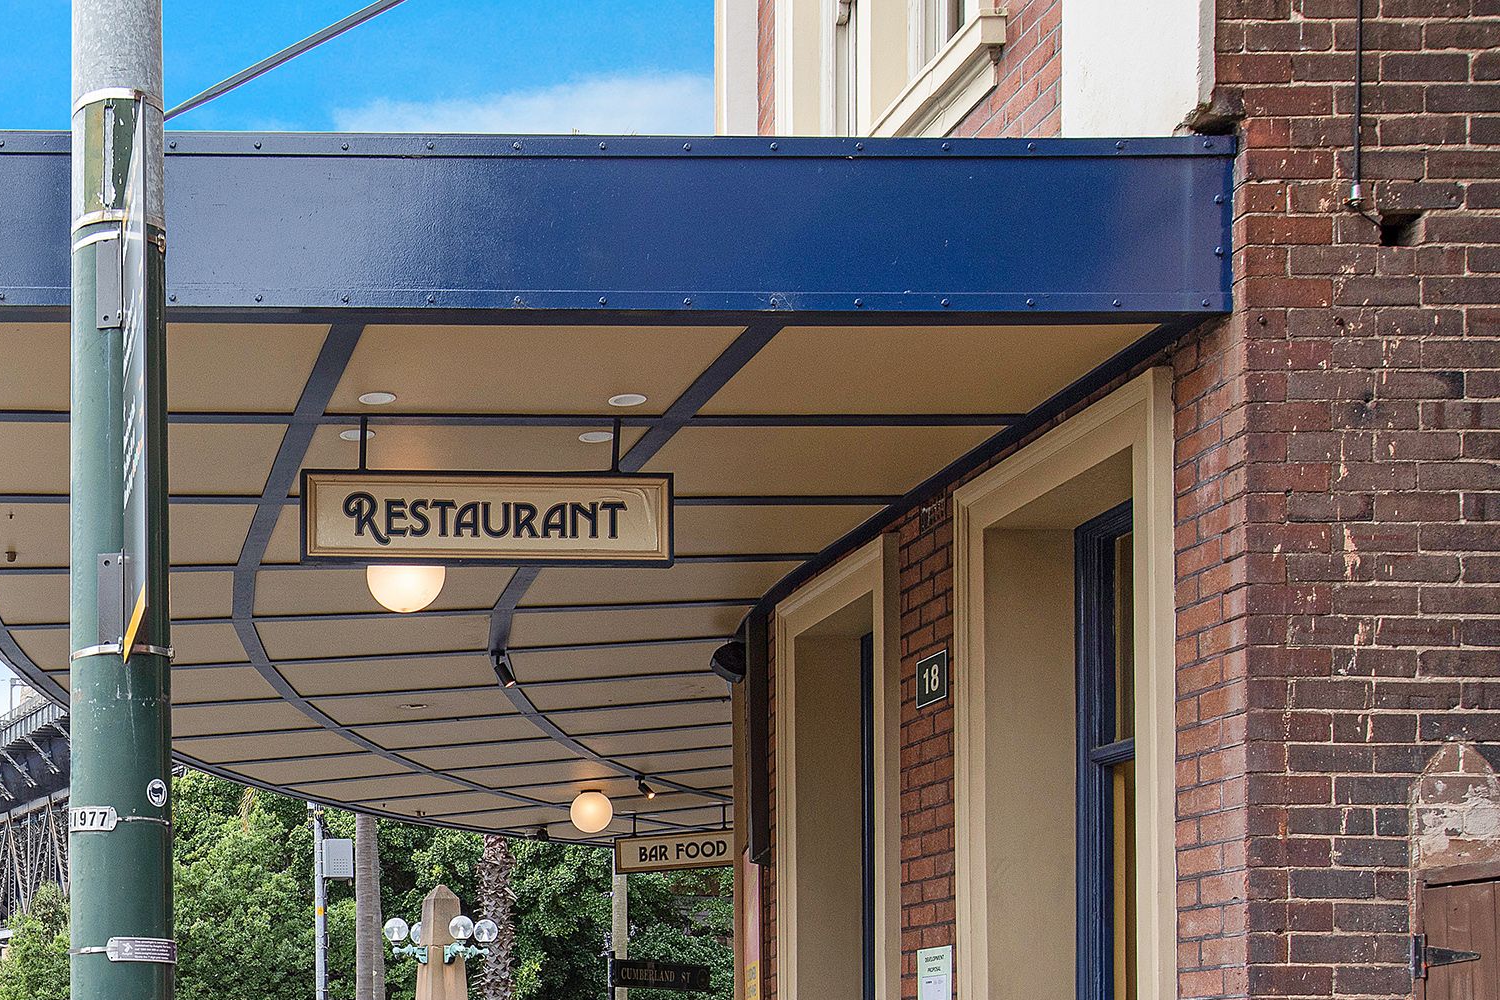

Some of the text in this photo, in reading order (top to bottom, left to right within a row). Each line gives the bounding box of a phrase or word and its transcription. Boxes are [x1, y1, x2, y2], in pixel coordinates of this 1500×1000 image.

[342, 491, 628, 546] RESTAURANT
[923, 664, 939, 694] 18
[70, 811, 108, 827] 1977
[638, 840, 727, 862] BAR FOOD
[621, 967, 691, 983] CUMBERLAND ST
